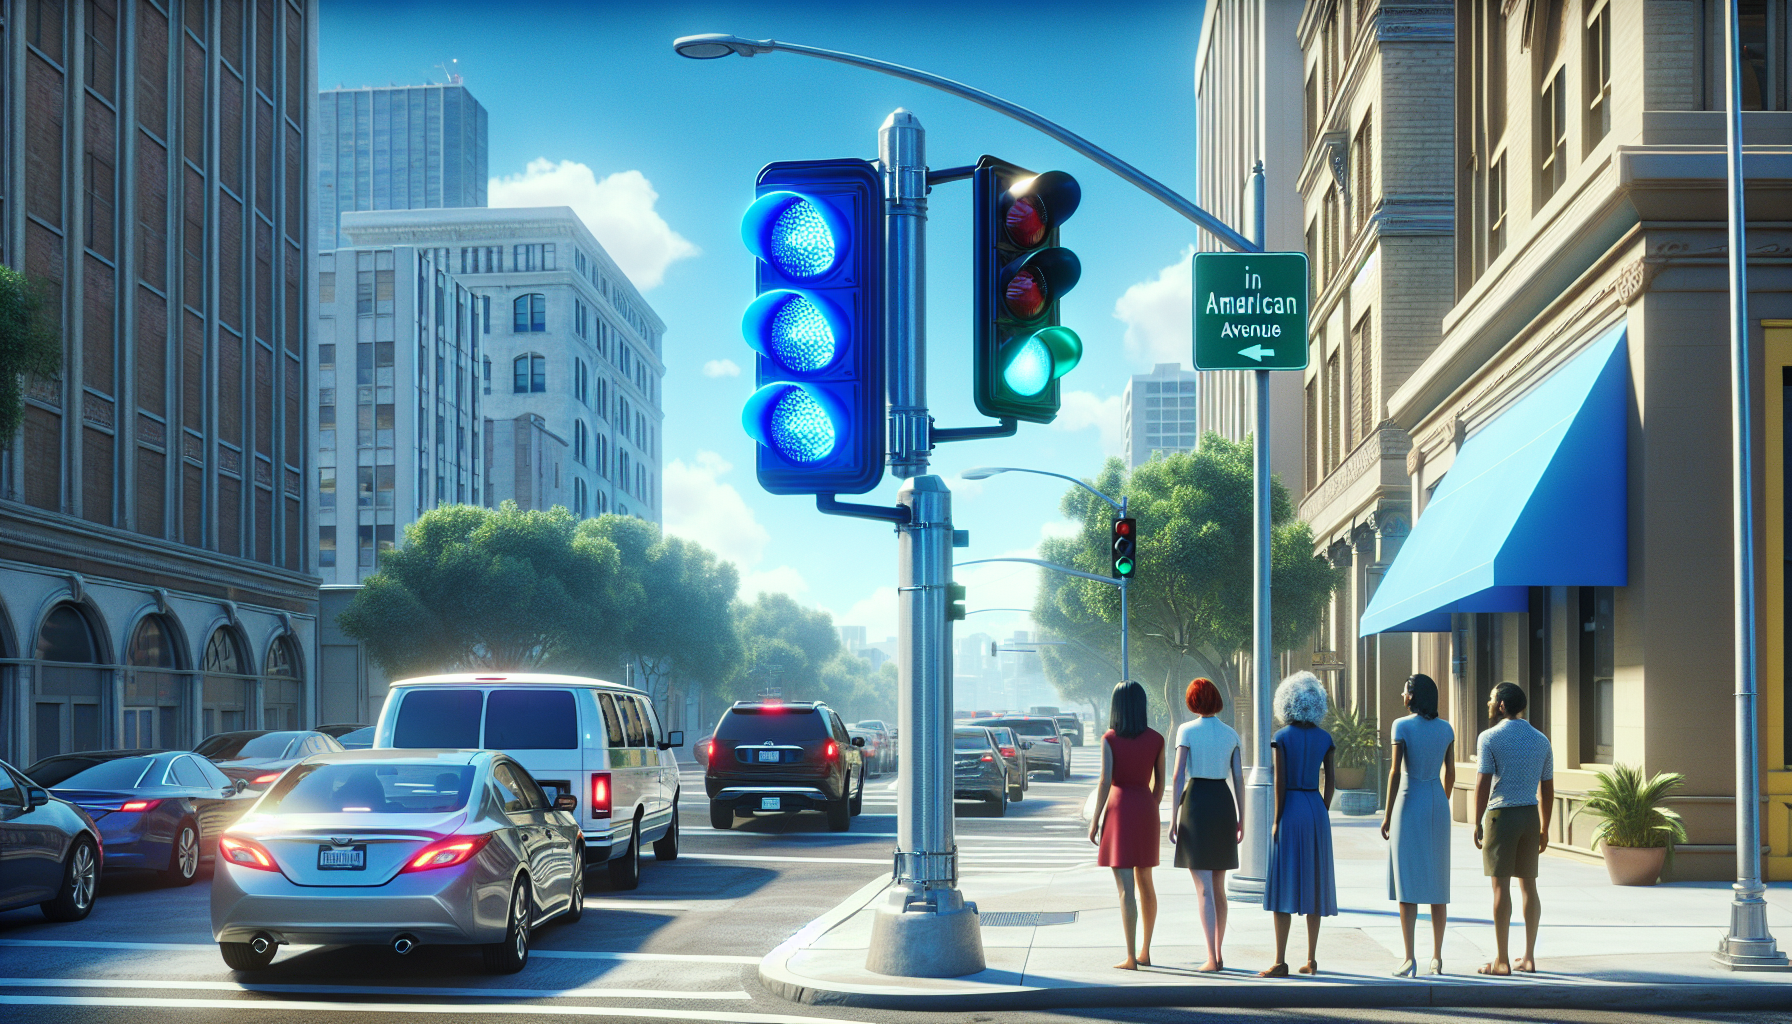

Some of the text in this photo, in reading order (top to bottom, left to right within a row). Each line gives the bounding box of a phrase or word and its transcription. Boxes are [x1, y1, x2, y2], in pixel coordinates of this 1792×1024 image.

[1245, 265, 1261, 290] in
[1206, 291, 1297, 315] American
[1221, 321, 1281, 338] Avenue
